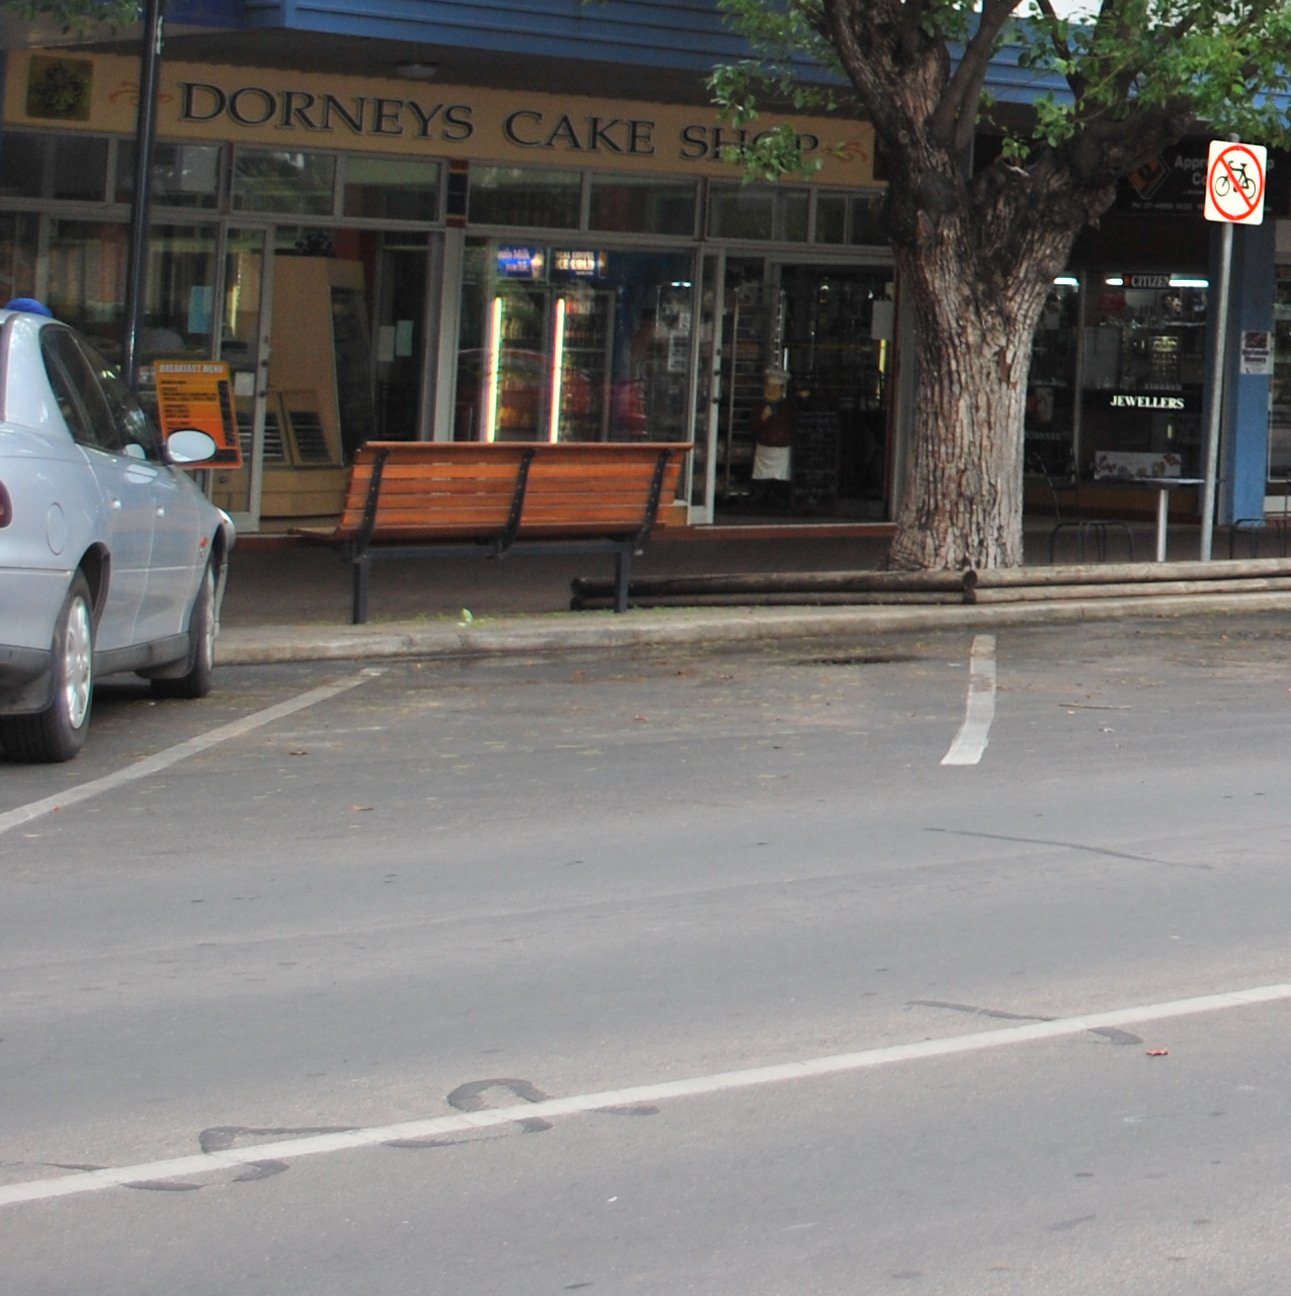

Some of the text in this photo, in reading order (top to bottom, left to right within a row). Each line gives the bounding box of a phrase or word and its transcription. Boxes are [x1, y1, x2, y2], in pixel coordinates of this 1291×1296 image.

[179, 80, 475, 143] DORNEYS
[503, 110, 657, 160] CAKE
[570, 259, 596, 271] COLD
[1131, 275, 1170, 288] CITIZEN
[1109, 394, 1185, 410] JEWELLERS
